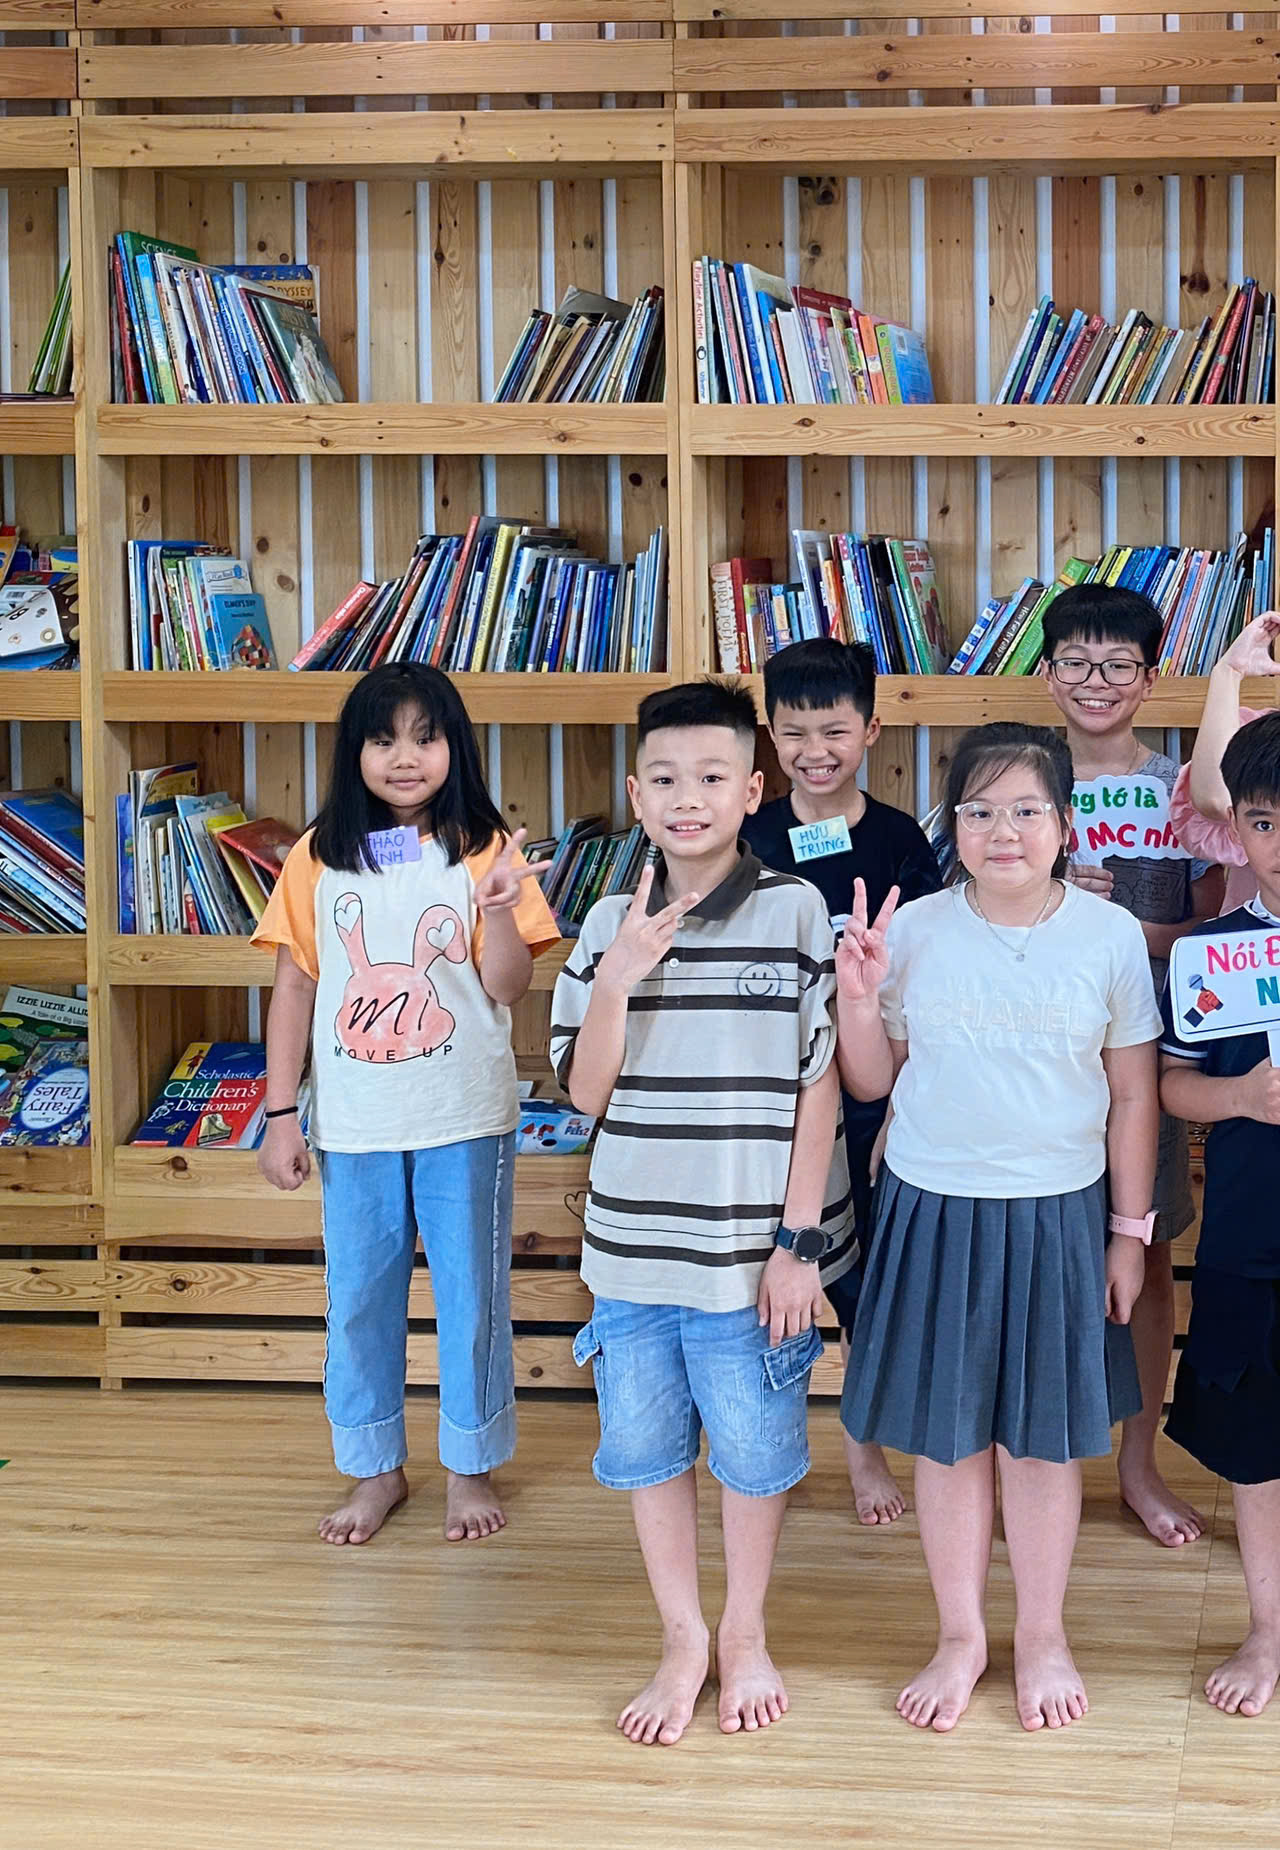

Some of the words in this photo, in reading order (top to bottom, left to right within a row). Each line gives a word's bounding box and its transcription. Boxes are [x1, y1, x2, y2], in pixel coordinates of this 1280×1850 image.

[715, 578, 732, 610] FIRST
[718, 613, 737, 652] POEMS
[1102, 786, 1128, 808] tớ
[1134, 786, 1159, 808] là
[1086, 821, 1137, 851] MC
[798, 837, 846, 858] TRUNG
[1206, 941, 1262, 976] Nói
[333, 1045, 396, 1061] MOVE
[422, 1044, 454, 1058] UP
[195, 1069, 254, 1080] Scholastic
[33, 1086, 83, 1100] Tales
[164, 1082, 258, 1098] Children's
[22, 1098, 76, 1116] Fairy
[174, 1100, 252, 1112] Dictionary
